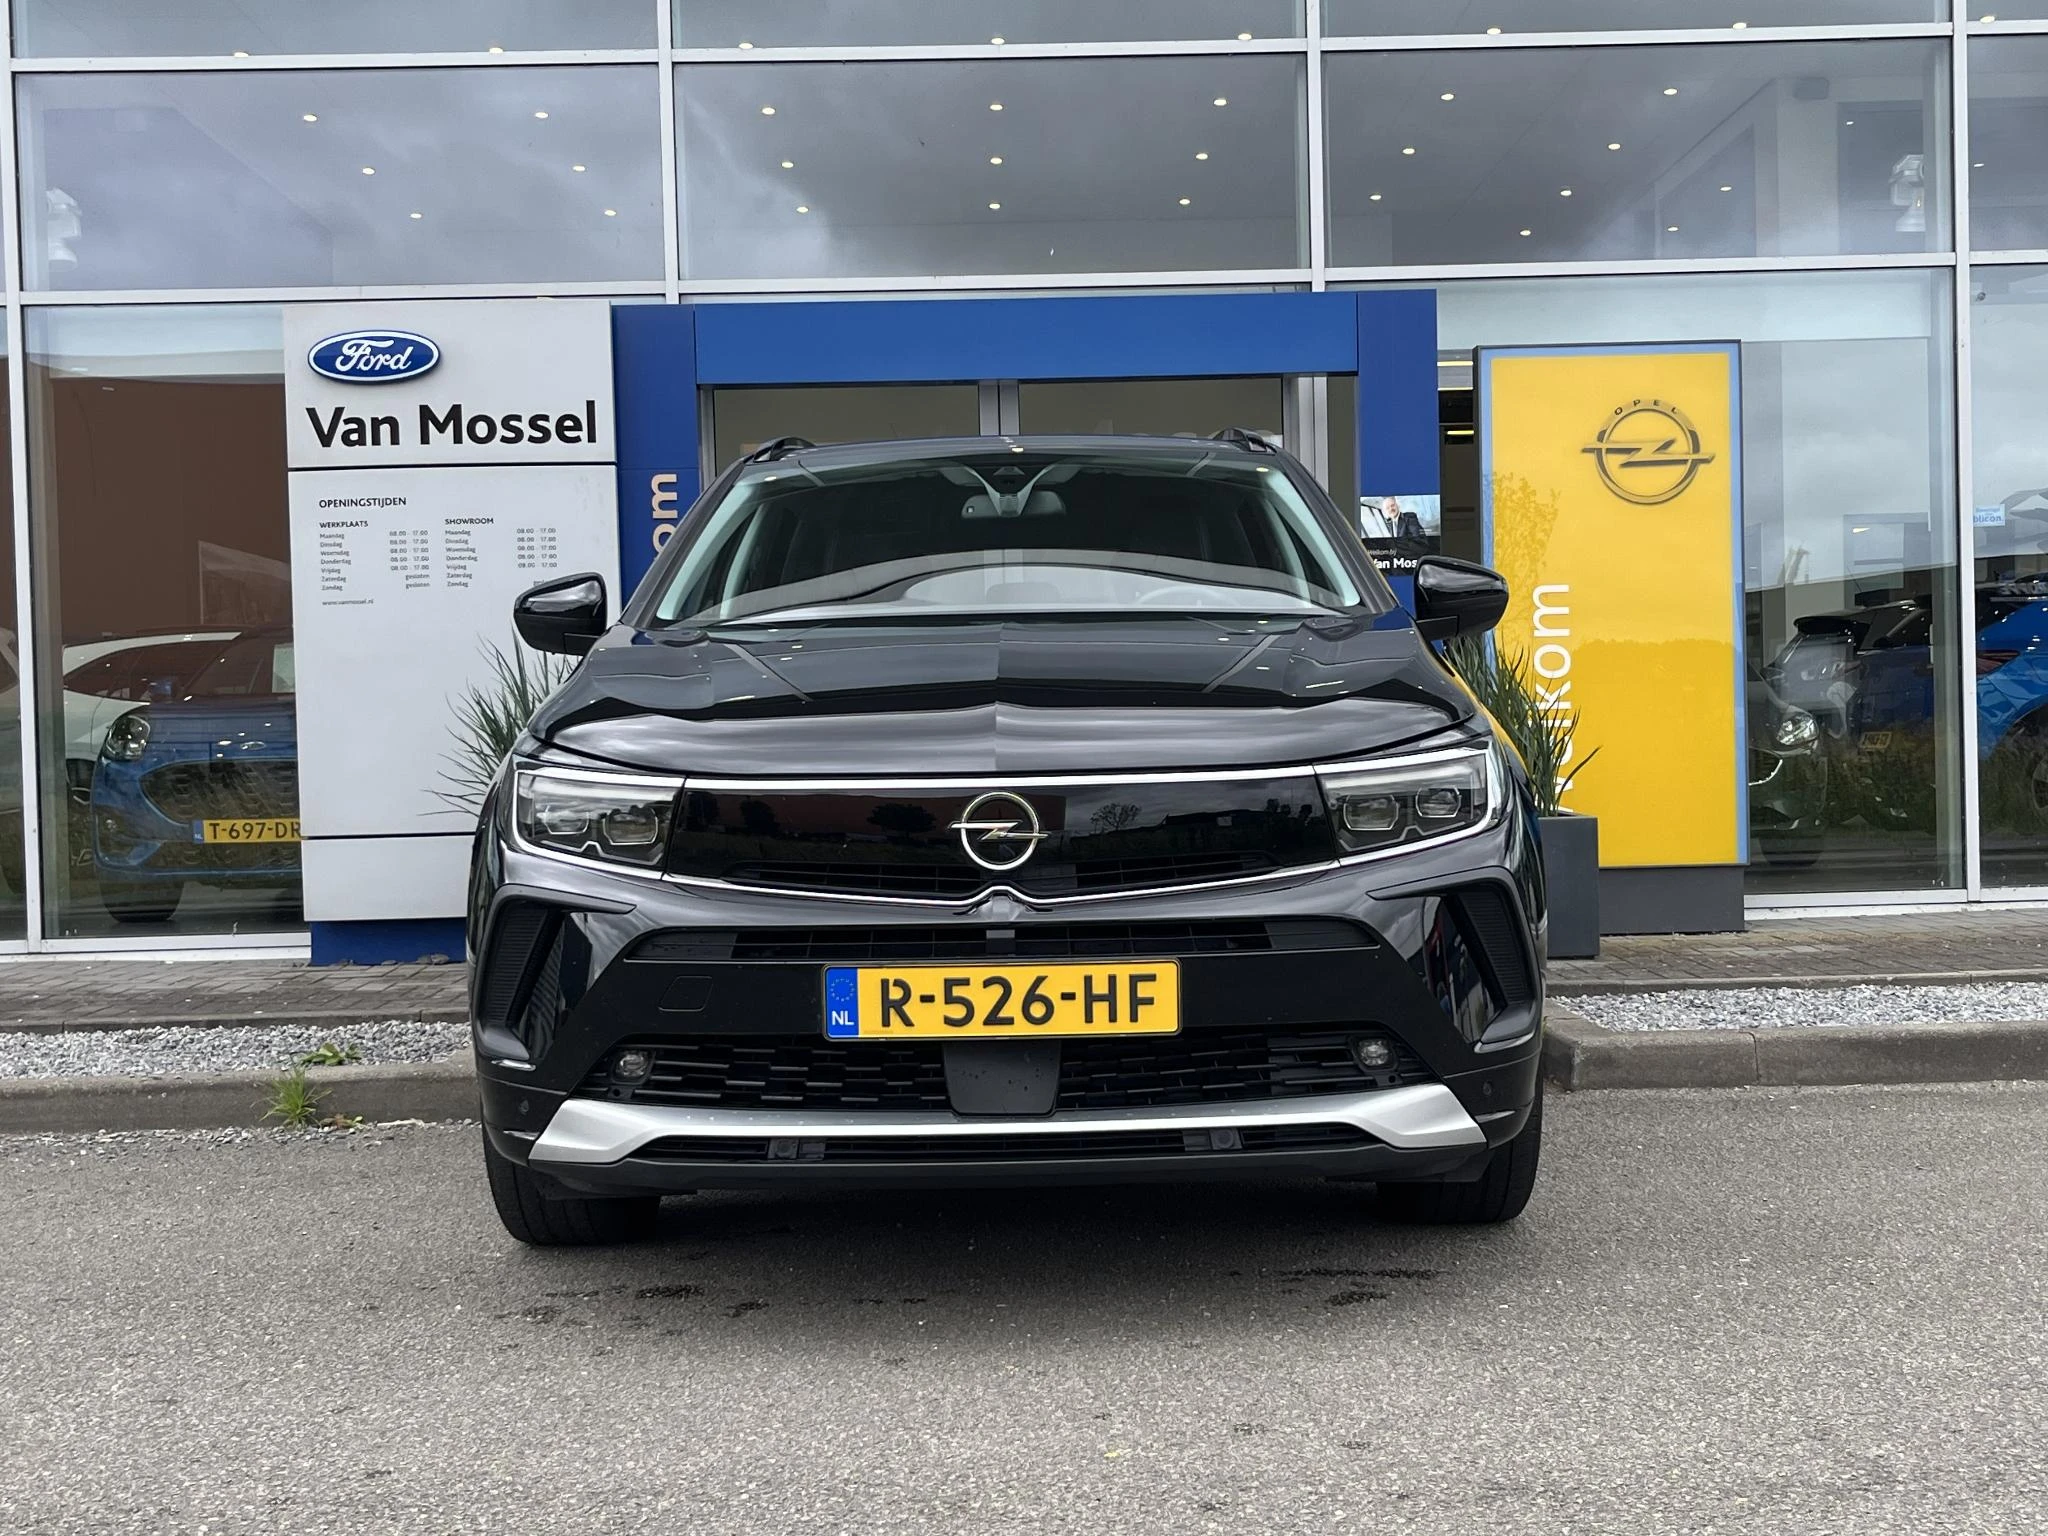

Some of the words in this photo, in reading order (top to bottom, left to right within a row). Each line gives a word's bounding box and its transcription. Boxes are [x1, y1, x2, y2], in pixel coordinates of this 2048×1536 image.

[336, 339, 414, 372] Ford
[1614, 399, 1679, 416] OPEL
[305, 406, 400, 448] Van
[418, 400, 597, 445] Mossel
[318, 497, 407, 509] OPENINGSTIJDEN
[319, 520, 369, 529] WERKPLAATS
[444, 517, 495, 525] SHOWROOM
[880, 973, 1158, 1028] R-526-HF
[831, 1010, 855, 1026] NL
